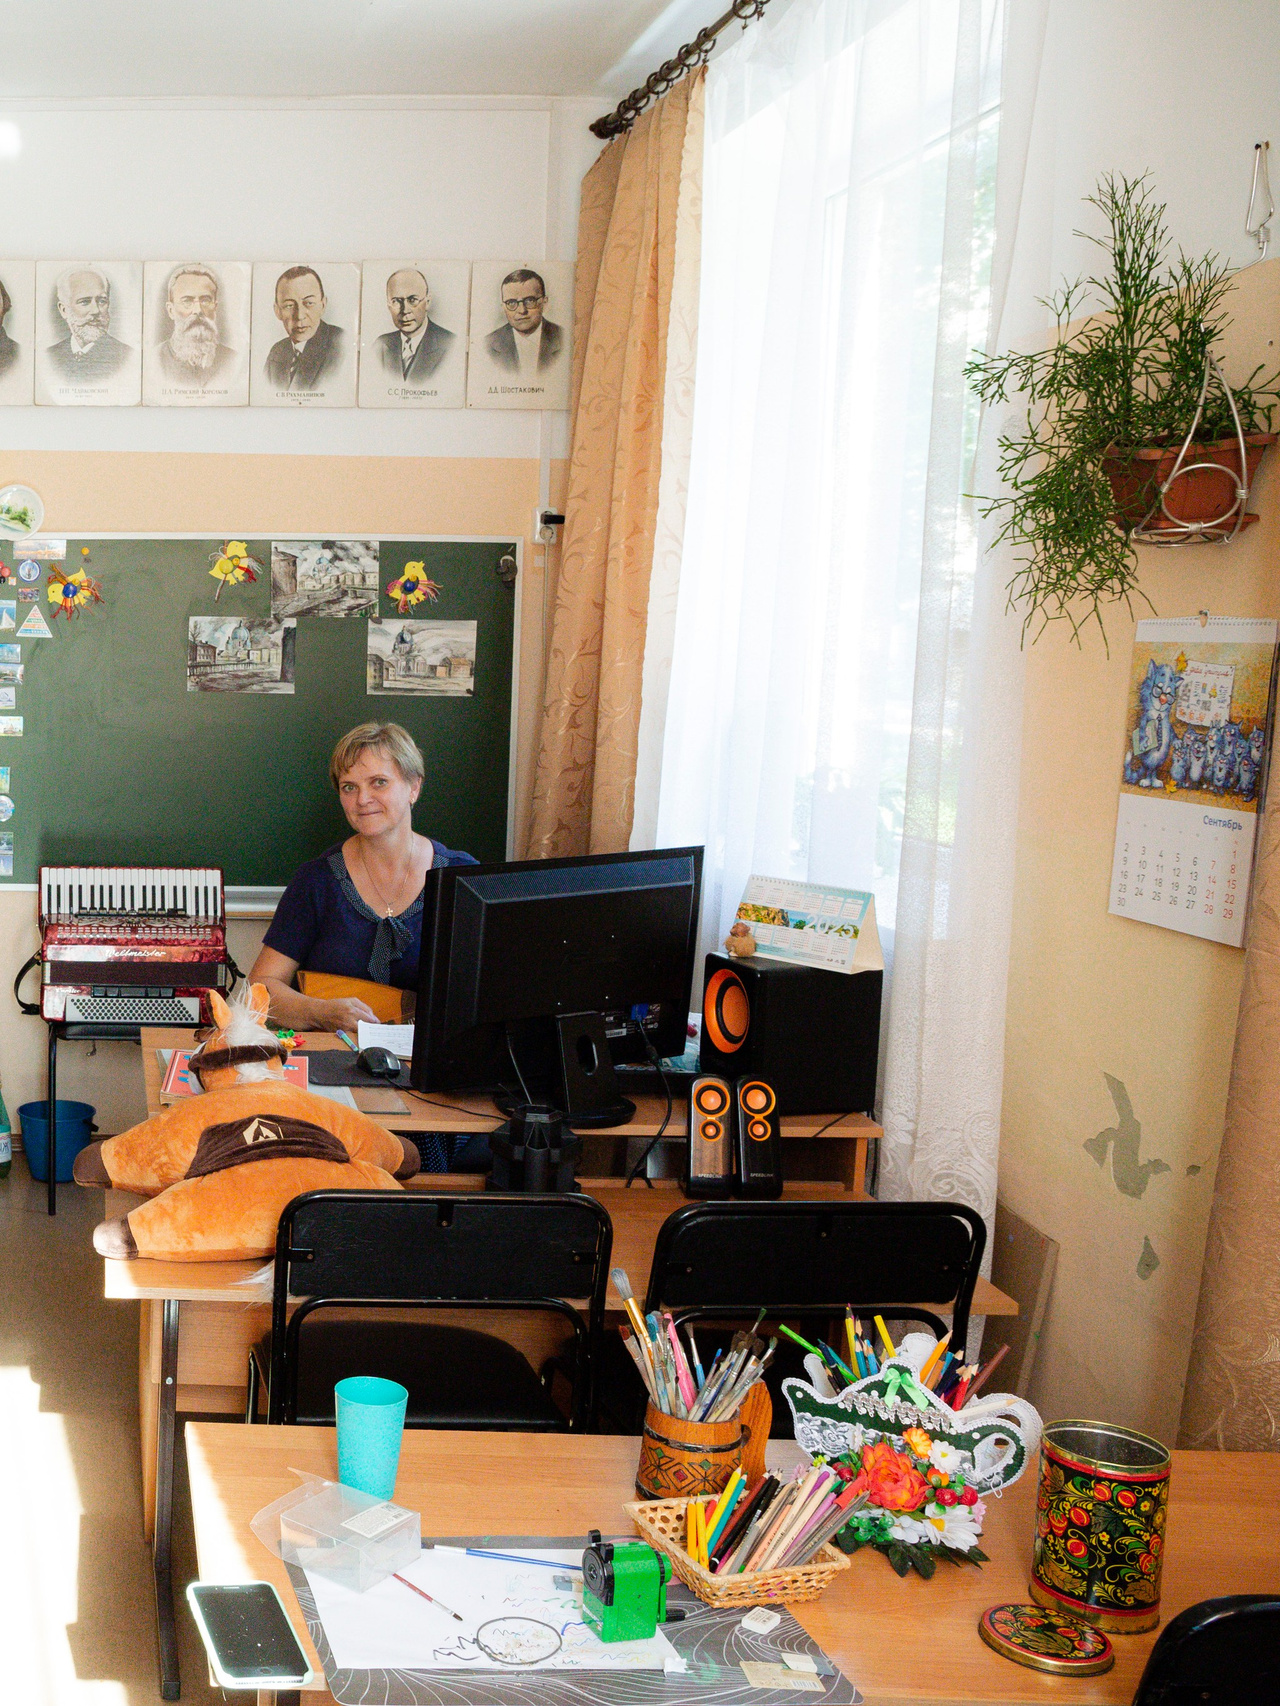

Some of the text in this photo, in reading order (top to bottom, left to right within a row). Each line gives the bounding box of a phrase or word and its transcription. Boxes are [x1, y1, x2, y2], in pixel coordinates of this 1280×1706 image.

[400, 388, 438, 396] ПРОКОФЬЕВ
[1203, 815, 1243, 832] Сентябрь
[1124, 843, 1129, 852] 2
[1141, 846, 1146, 855] 3
[1176, 852, 1180, 862] 5
[1193, 857, 1198, 866] 6
[1233, 850, 1237, 859] 1
[1123, 857, 1236, 881] 9 10 11 12 13 7 8
[1121, 870, 1236, 895] 16 17 18 19 20 14 15
[1118, 883, 1235, 909] 23 24 25 26 27 21 22
[1117, 897, 1233, 919] 30 28 29
[802, 914, 855, 939] 2025
[105, 949, 166, 958] Weltmeister
